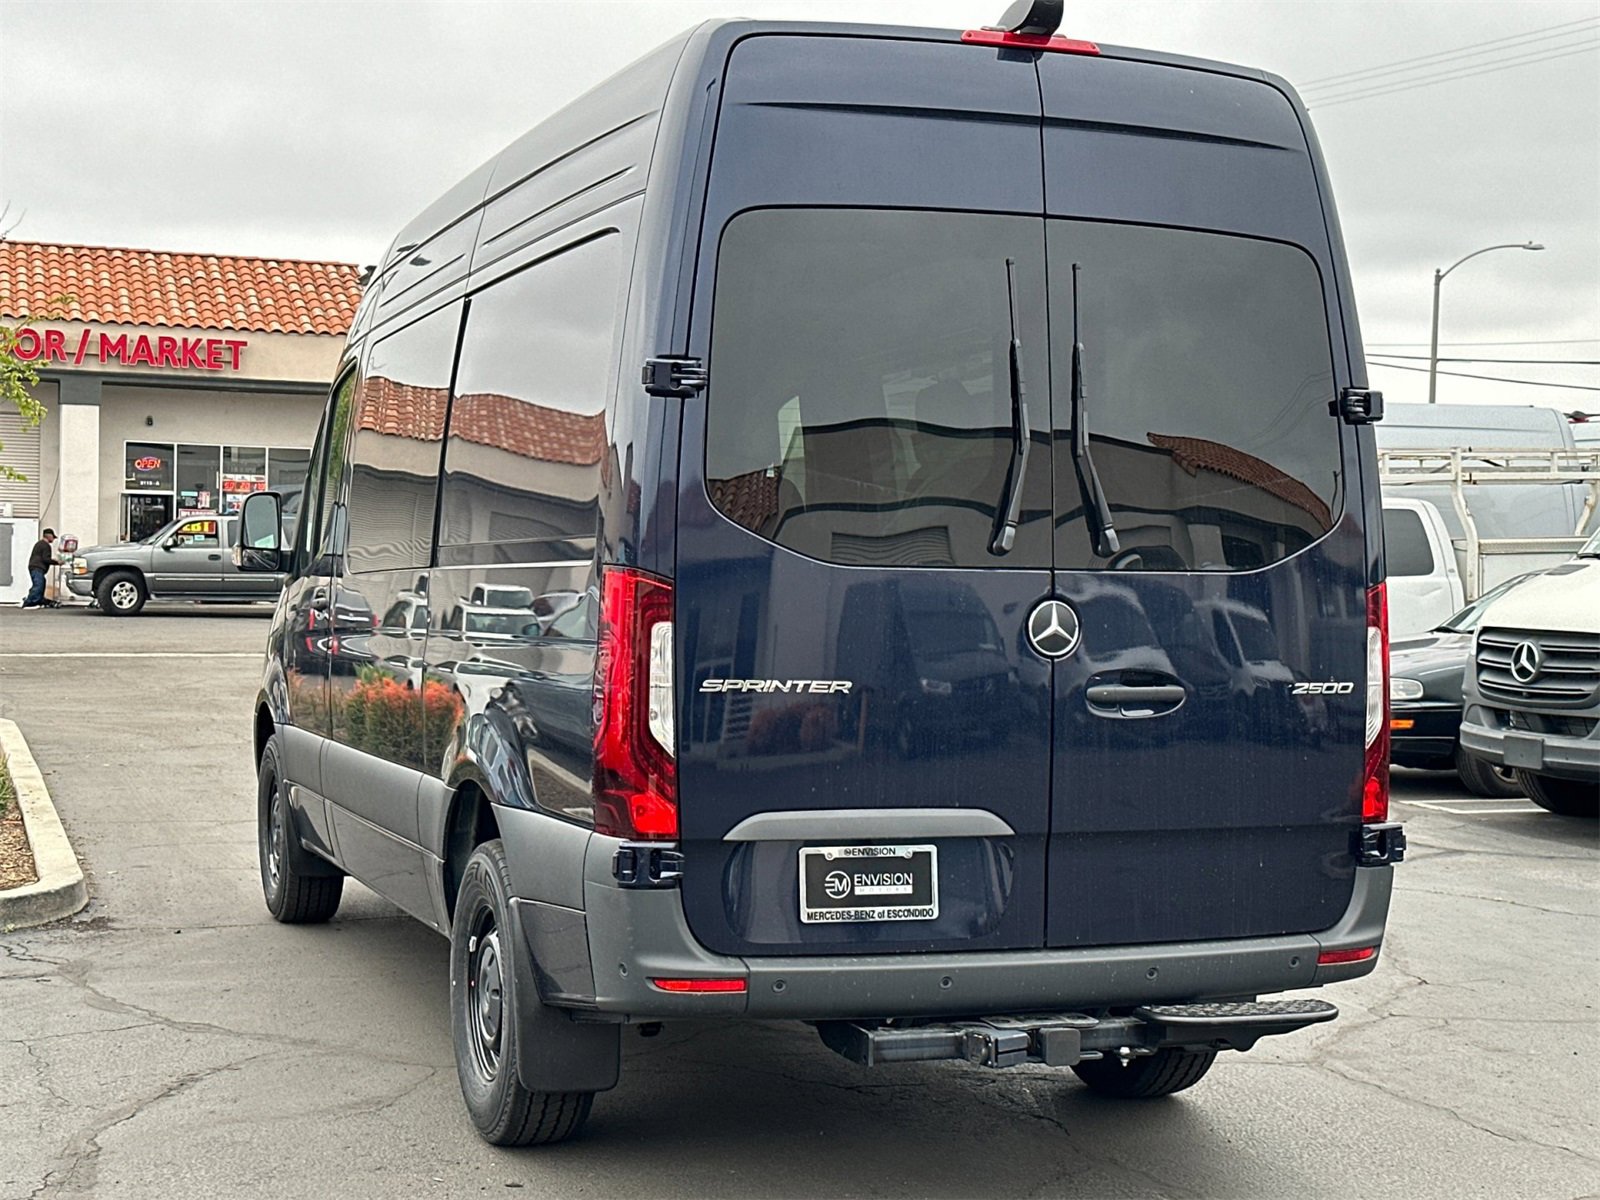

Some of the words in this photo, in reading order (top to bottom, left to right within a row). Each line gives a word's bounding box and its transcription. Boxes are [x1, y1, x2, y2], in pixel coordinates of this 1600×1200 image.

[0, 327, 67, 361] OR
[100, 333, 248, 370] MARKET
[134, 459, 161, 469] OPEN
[699, 679, 853, 694] SPRINTER
[1292, 682, 1354, 695] 2500
[852, 847, 896, 857] ENVISION
[854, 873, 913, 886] ENVISION
[806, 909, 876, 921] MERCEDES-BENZ
[877, 910, 886, 919] of
[887, 908, 934, 918] ESCONDIDO
